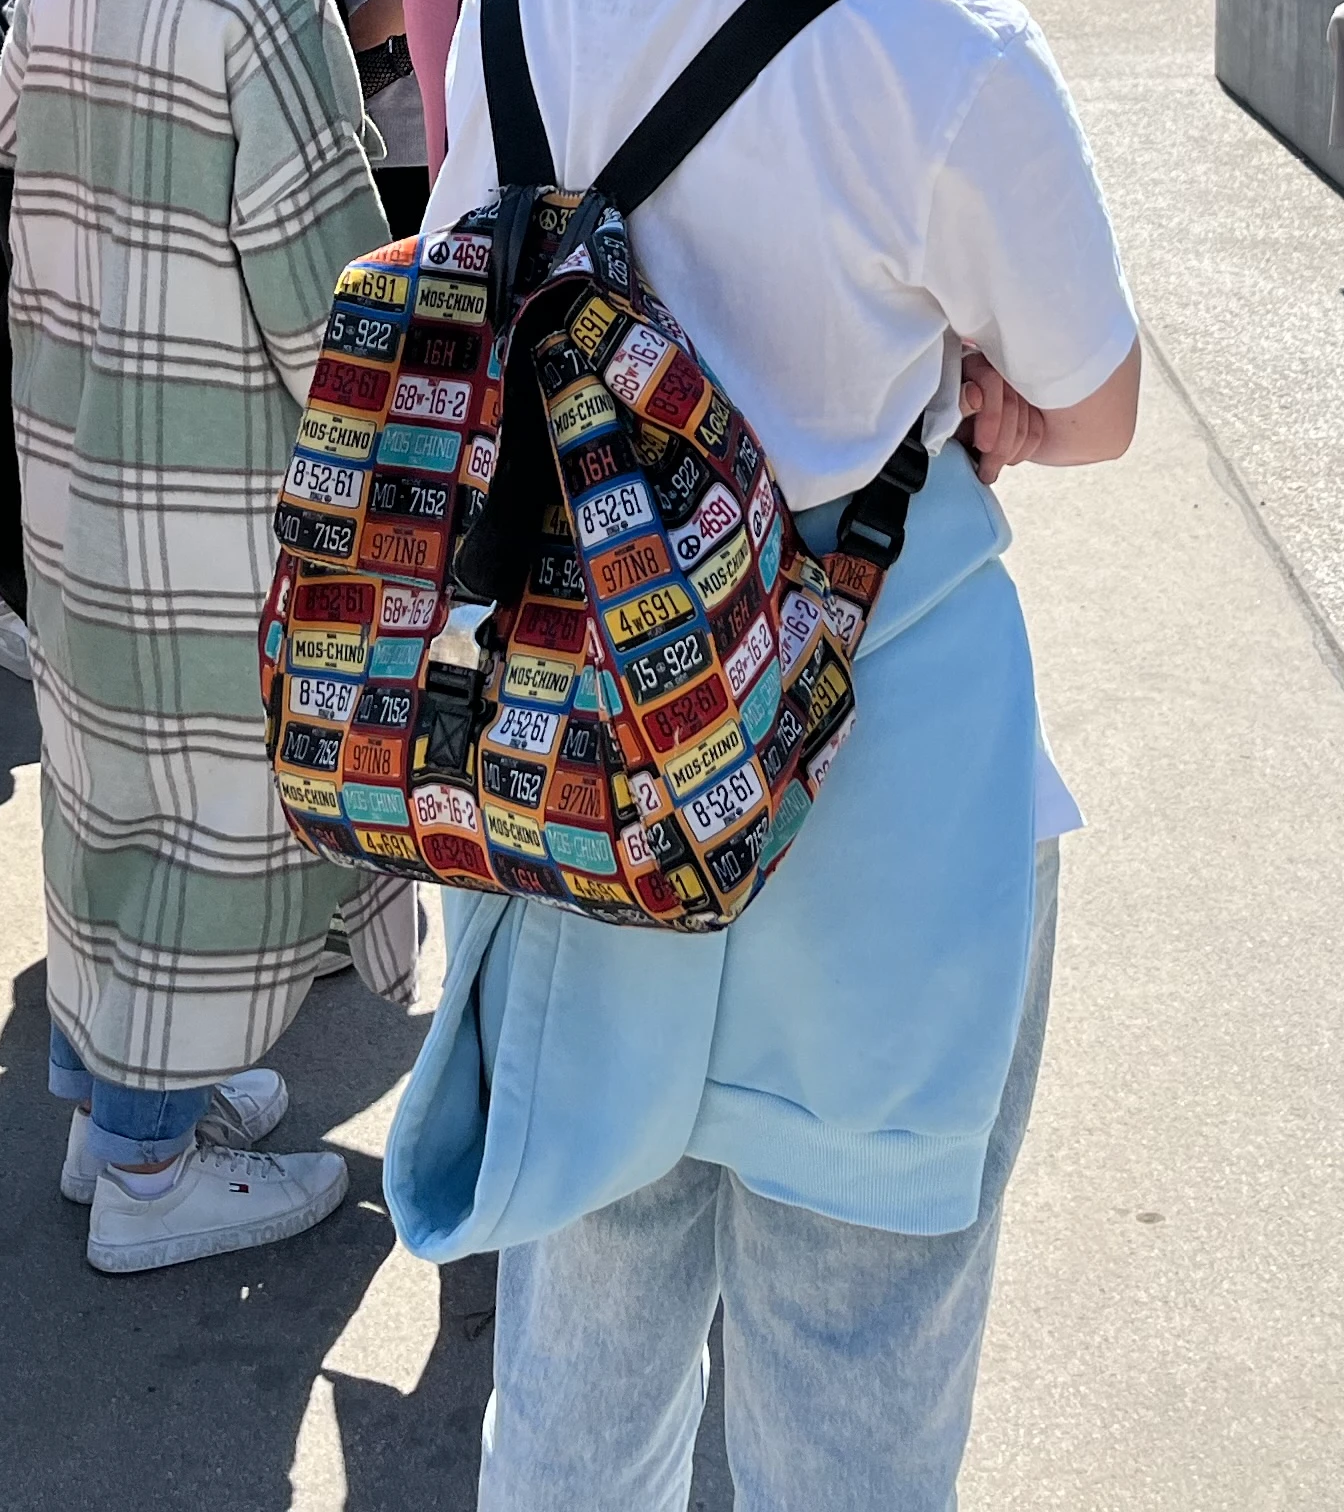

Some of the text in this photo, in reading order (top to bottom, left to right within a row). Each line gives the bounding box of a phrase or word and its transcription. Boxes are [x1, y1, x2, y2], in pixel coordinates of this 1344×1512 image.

[419, 288, 484, 315] MOS-CHINO
[357, 319, 392, 351] 922
[699, 495, 737, 539] 4691
[295, 639, 365, 663] MOS-CHINO
[632, 658, 658, 692] 15
[663, 634, 703, 677] 922
[507, 666, 569, 693] MOS-CHINO
[674, 729, 738, 788] MOS-CHINO
[282, 781, 336, 809] MOS-CHINO
[488, 816, 541, 848] MOS-CHINO
